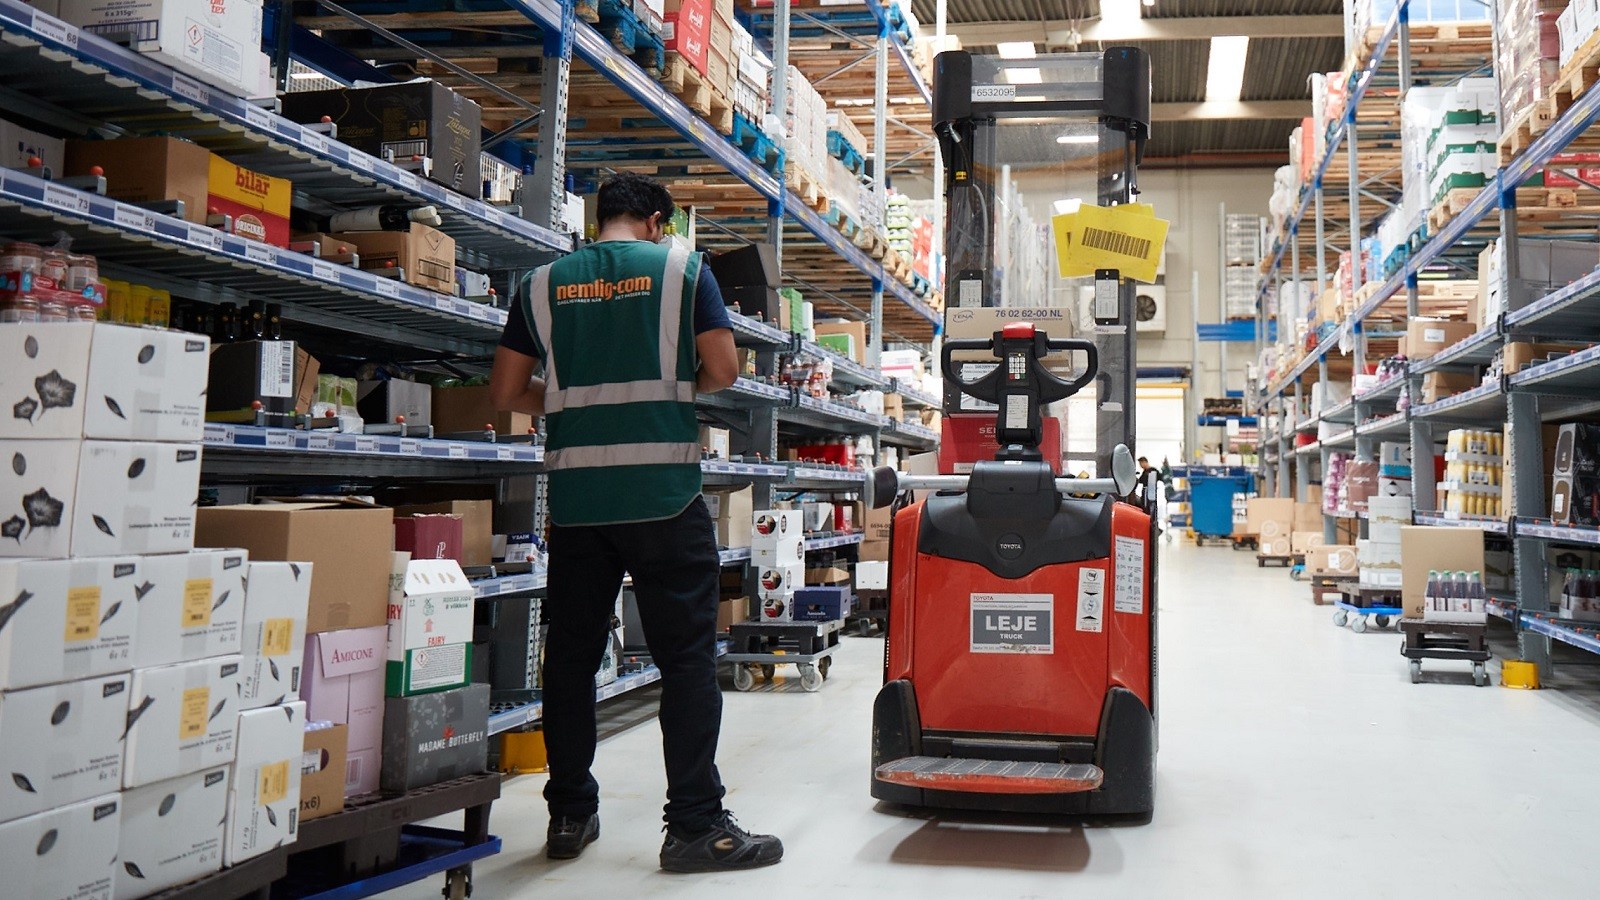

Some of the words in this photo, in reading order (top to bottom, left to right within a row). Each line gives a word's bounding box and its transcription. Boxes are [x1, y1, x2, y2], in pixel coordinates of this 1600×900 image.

[211, 6, 226, 15] tex
[67, 32, 77, 45] 68
[976, 88, 1015, 97] 6532095
[235, 167, 271, 196] bilar
[78, 198, 88, 209] 73
[144, 216, 154, 227] 82
[995, 309, 1006, 317] 76
[1008, 309, 1019, 318] 02
[1022, 309, 1048, 318] 62-00
[1050, 310, 1063, 318] NL
[225, 431, 234, 440] 41
[387, 604, 403, 620] IRY
[985, 615, 1037, 631] LEJE
[428, 635, 446, 647] FAIRY
[418, 738, 446, 754] MADAME
[448, 730, 484, 748] BUTTERFLY
